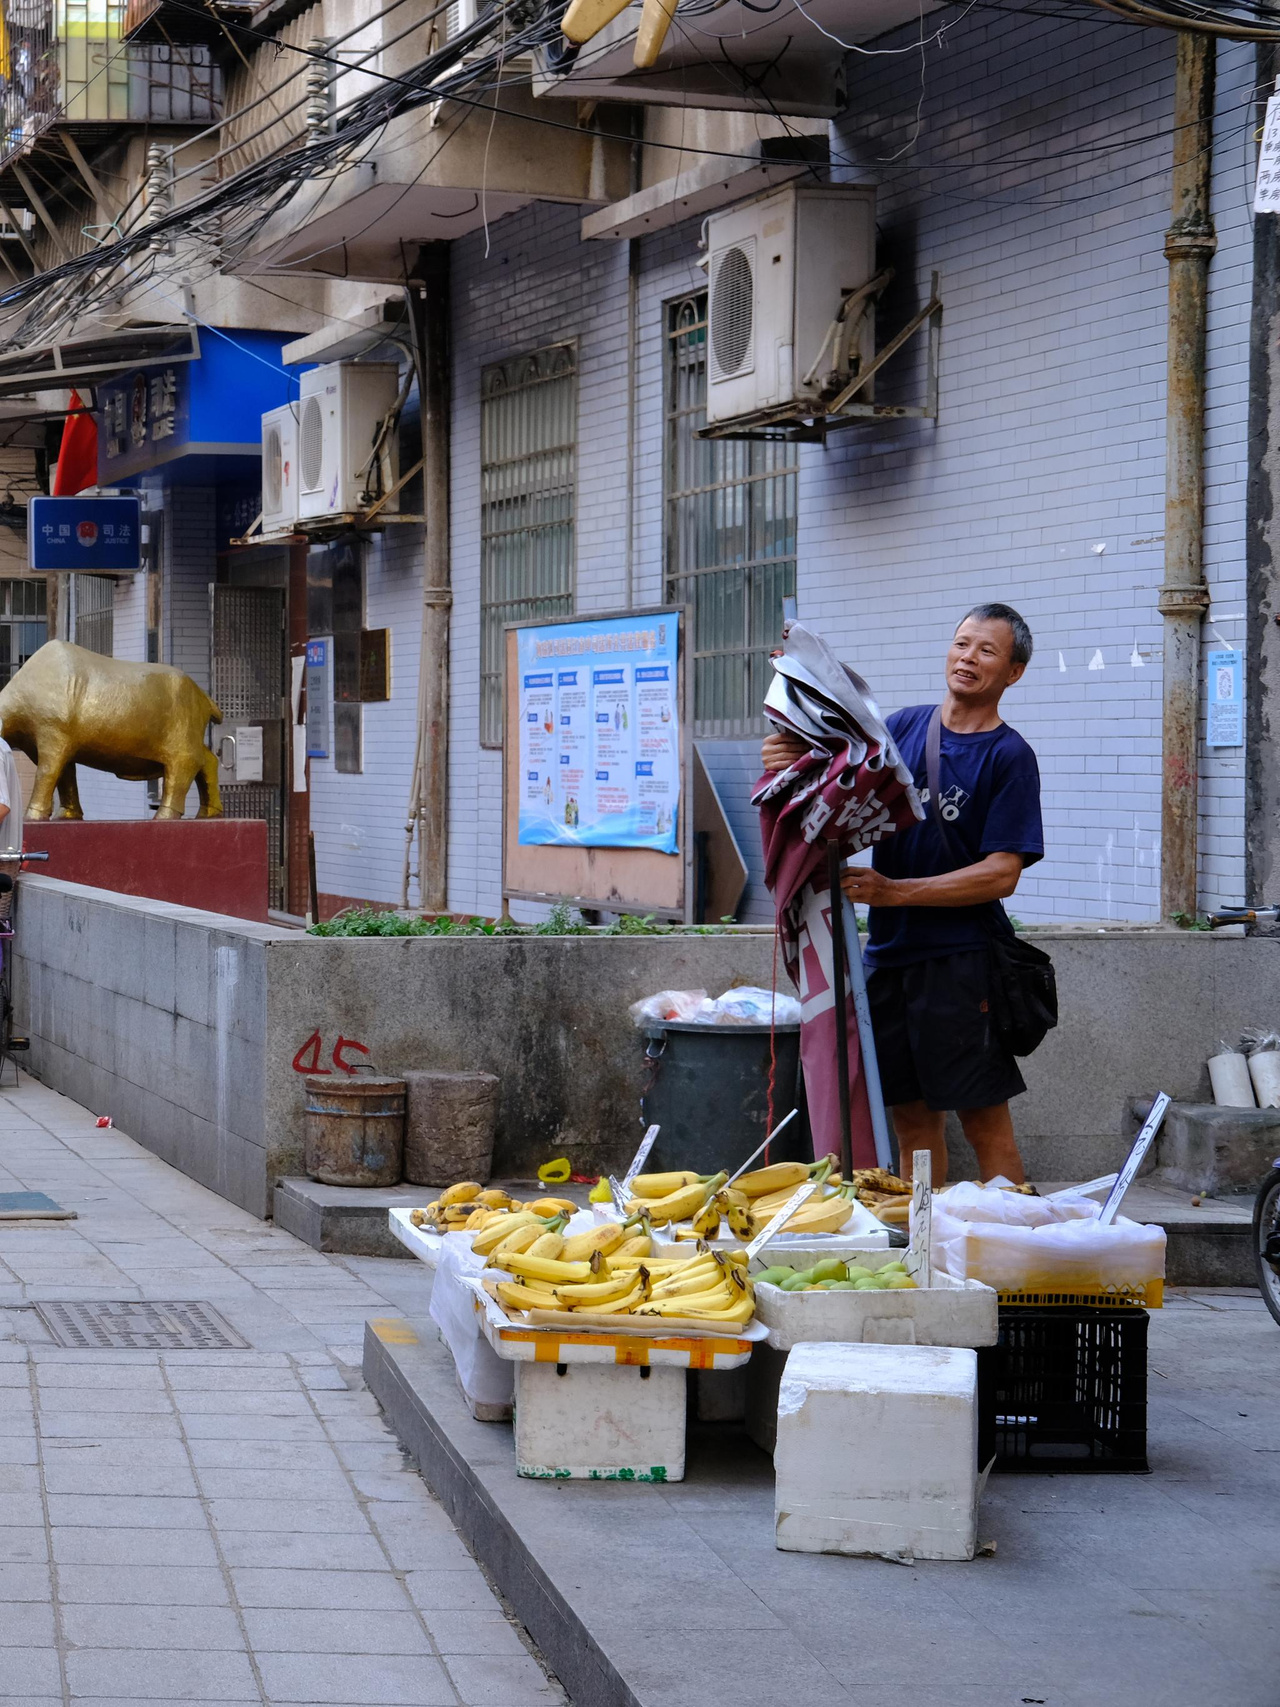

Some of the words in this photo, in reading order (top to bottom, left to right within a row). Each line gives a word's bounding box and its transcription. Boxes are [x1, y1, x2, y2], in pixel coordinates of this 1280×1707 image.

[151, 369, 176, 417] 司法
[42, 524, 70, 536] 中国
[102, 524, 131, 537] 司法
